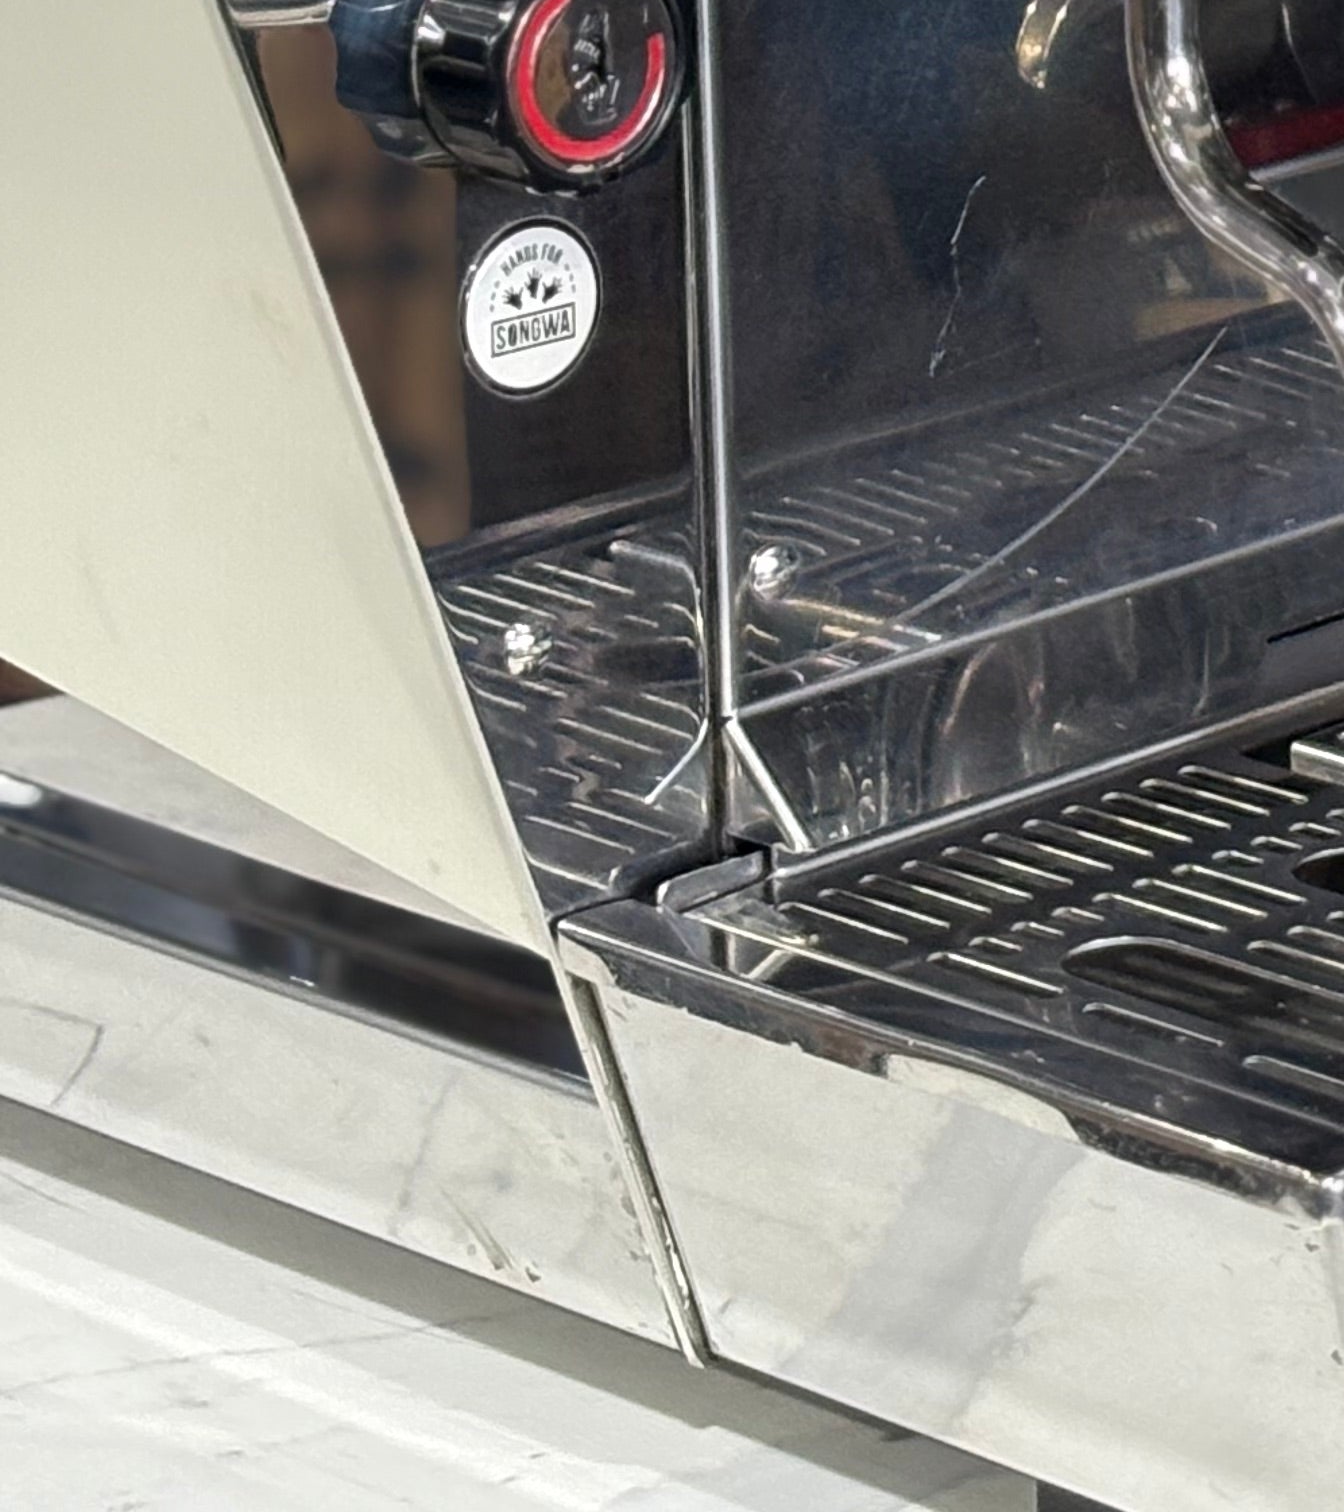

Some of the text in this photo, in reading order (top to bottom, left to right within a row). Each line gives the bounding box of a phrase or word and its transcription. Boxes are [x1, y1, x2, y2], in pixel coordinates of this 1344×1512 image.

[500, 243, 564, 277] HANDS FOR
[495, 309, 571, 351] SONGWA
